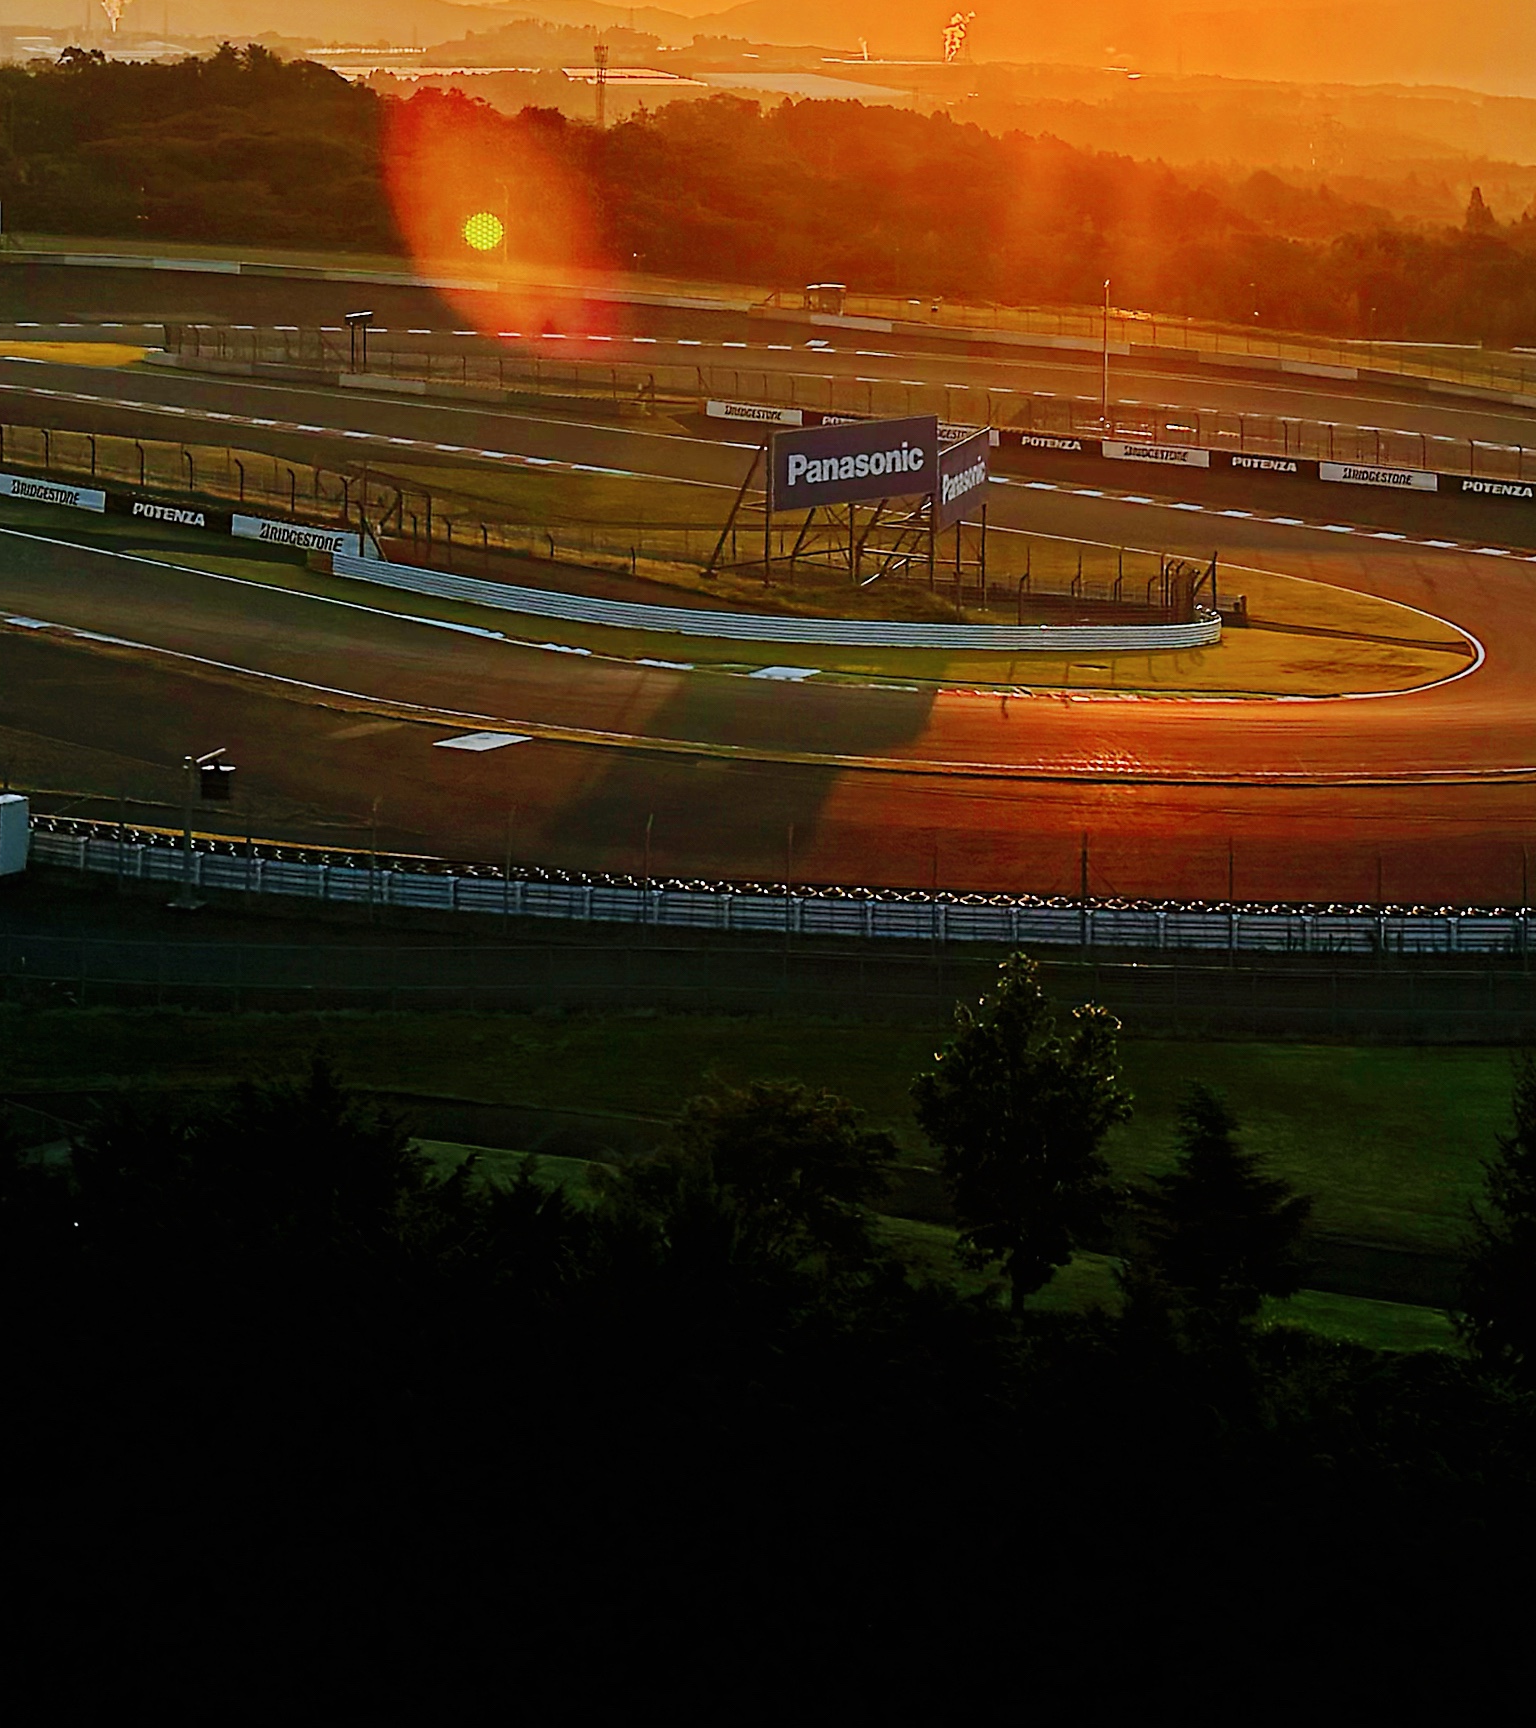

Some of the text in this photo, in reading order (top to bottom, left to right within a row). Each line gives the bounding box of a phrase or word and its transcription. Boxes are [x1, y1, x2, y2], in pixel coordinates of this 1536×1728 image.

[1021, 435, 1082, 451] POTENZA
[787, 441, 924, 486] Panasonic
[1232, 456, 1297, 472] POTENZA
[1343, 467, 1413, 486] BRIDGESTONE
[11, 479, 80, 506] BRIDGESTONE
[1462, 480, 1534, 498] POTENZA
[132, 502, 206, 527] POTENZA
[259, 522, 345, 553] BRIDGESTONE
